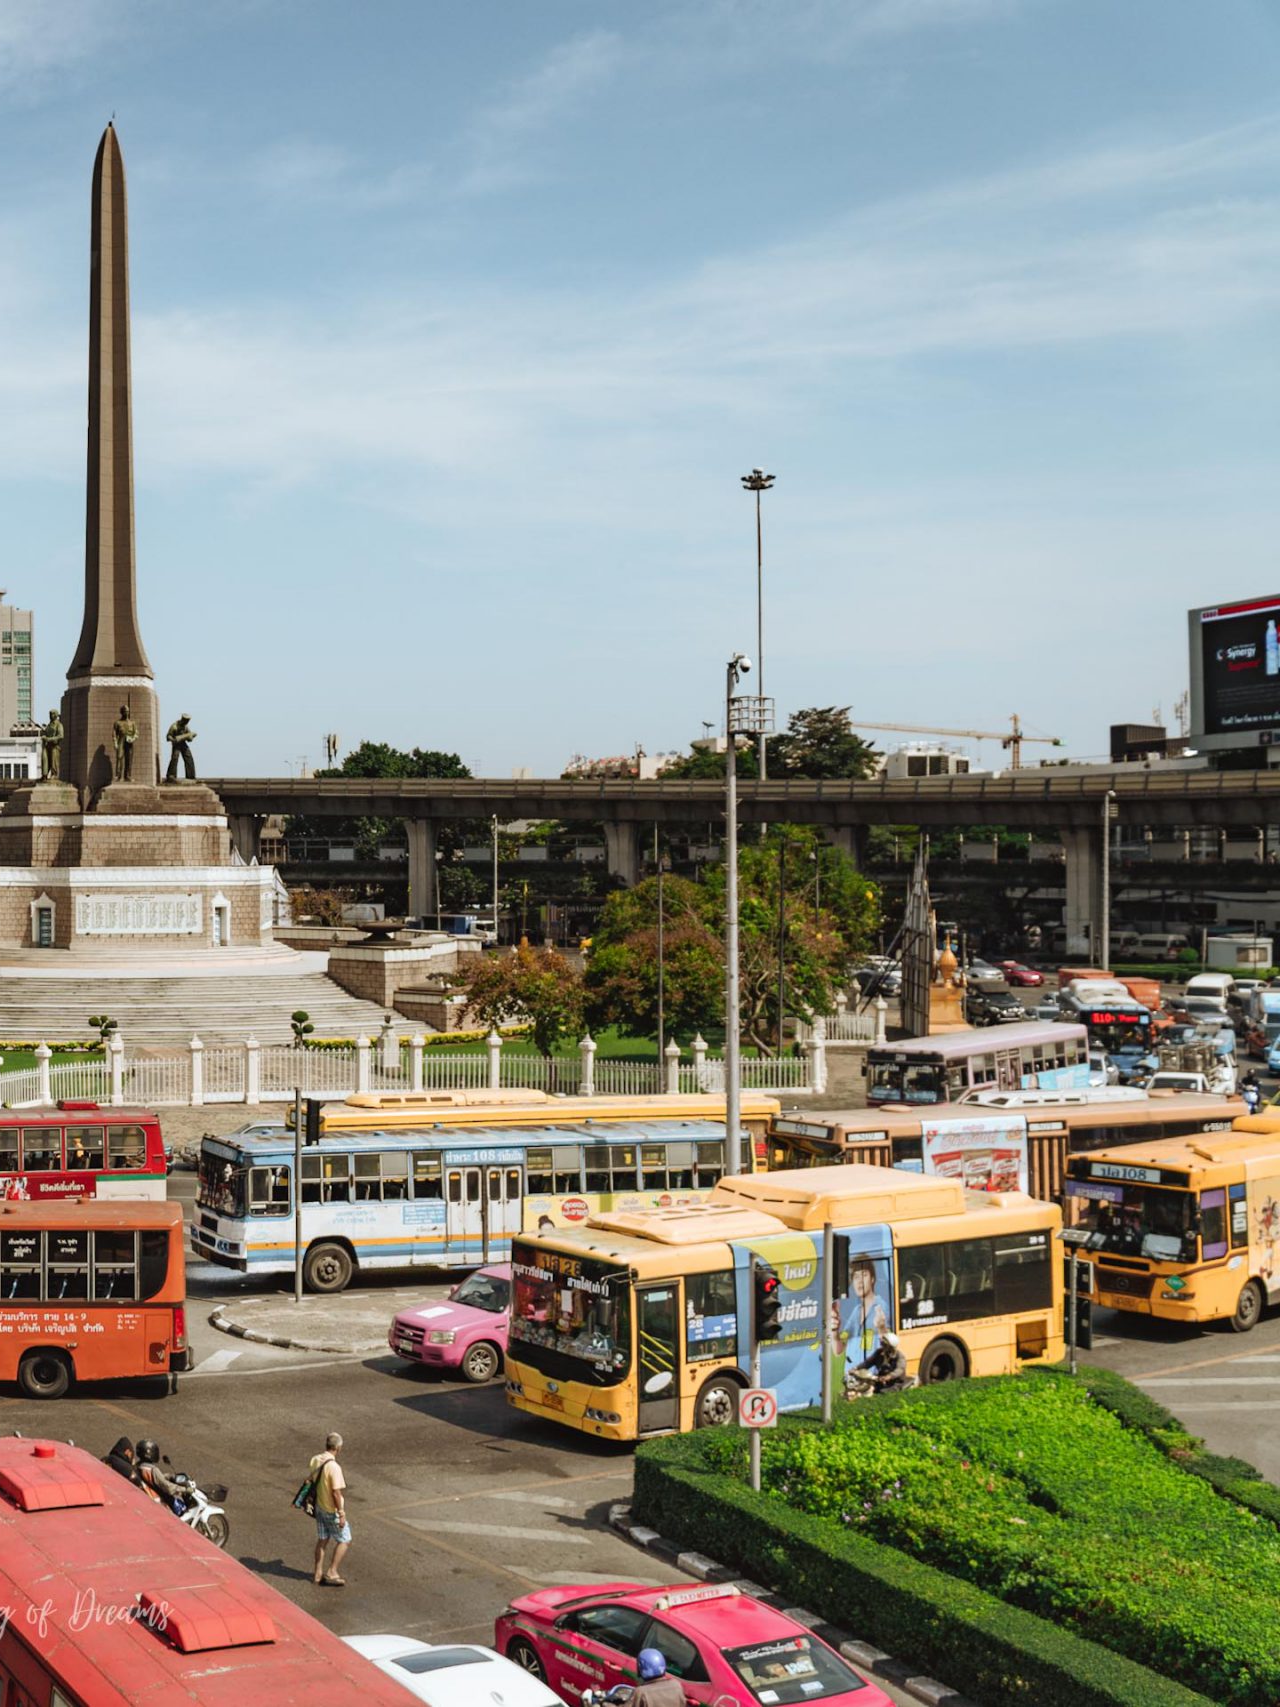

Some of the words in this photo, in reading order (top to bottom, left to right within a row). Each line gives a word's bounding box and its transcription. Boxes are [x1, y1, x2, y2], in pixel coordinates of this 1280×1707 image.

[1226, 646, 1257, 660] Synergy
[473, 1149, 496, 1161] 108
[1122, 1167, 1147, 1181] 108
[783, 1262, 811, 1280] ใหม่!
